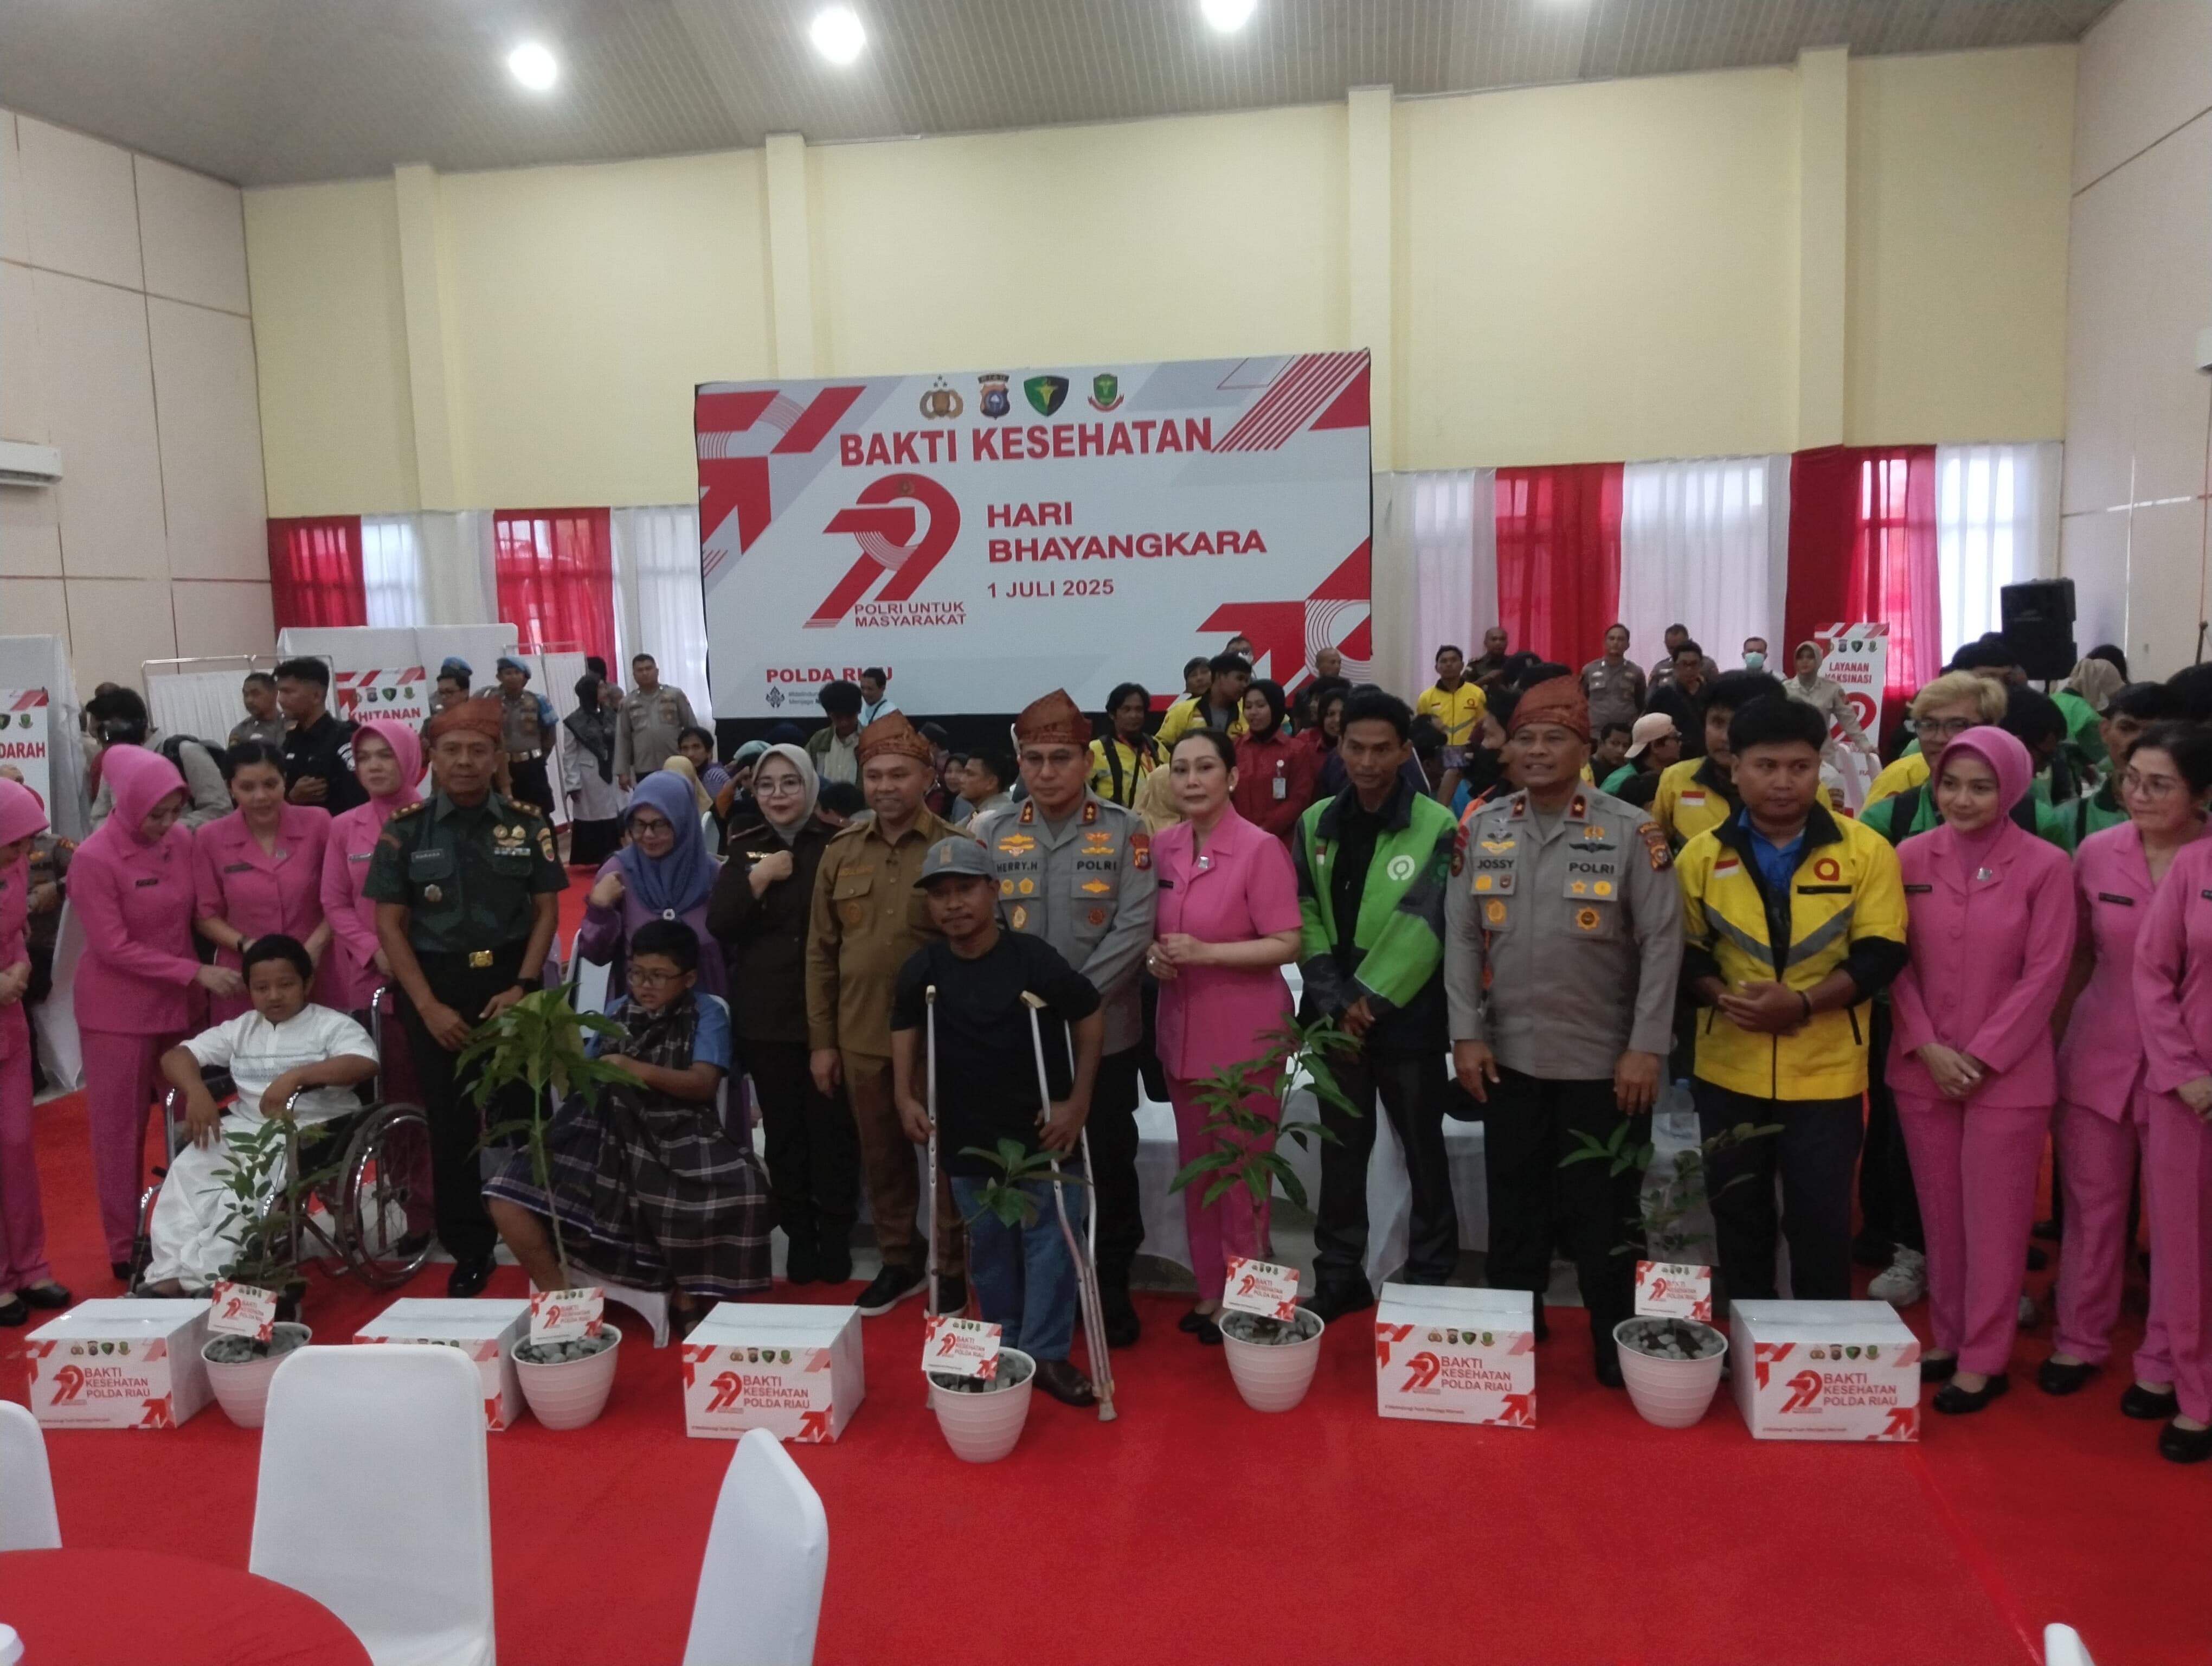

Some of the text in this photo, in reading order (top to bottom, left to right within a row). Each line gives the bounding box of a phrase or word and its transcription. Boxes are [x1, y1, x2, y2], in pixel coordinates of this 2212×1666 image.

[840, 417, 1211, 466] BAKTI KESEHATAN
[987, 502, 1072, 528] HARI
[988, 529, 1267, 563] BHAYANGKARA
[987, 579, 1114, 598] 1 JULI 2025
[854, 601, 964, 615] POLRI UNTUK
[854, 613, 967, 627] MASYARAKAT
[1829, 662, 1869, 671] LAYANAN
[766, 667, 892, 683] POLDA RI
[348, 707, 421, 722] KHITANAN
[1077, 861, 1117, 871] POLRI
[1477, 859, 1514, 869] JOSSY
[1569, 862, 1614, 874] POLRI
[1441, 1356, 1483, 1369] BAKTI
[85, 1367, 122, 1377] BAKTI
[1441, 1368, 1511, 1380] KESEHATAN
[85, 1378, 149, 1387] KESEHATAN
[743, 1374, 782, 1387] BAKTI
[1823, 1373, 1867, 1384] BAKTI
[1441, 1379, 1512, 1392] POLDA RIAU
[1824, 1385, 1896, 1394] KESEHATAN
[87, 1388, 150, 1398] POLDA RIAU
[743, 1387, 808, 1398] KESEHATAN
[743, 1398, 809, 1409] POLDA RIAU
[1823, 1396, 1898, 1406] POLDA RIAU
